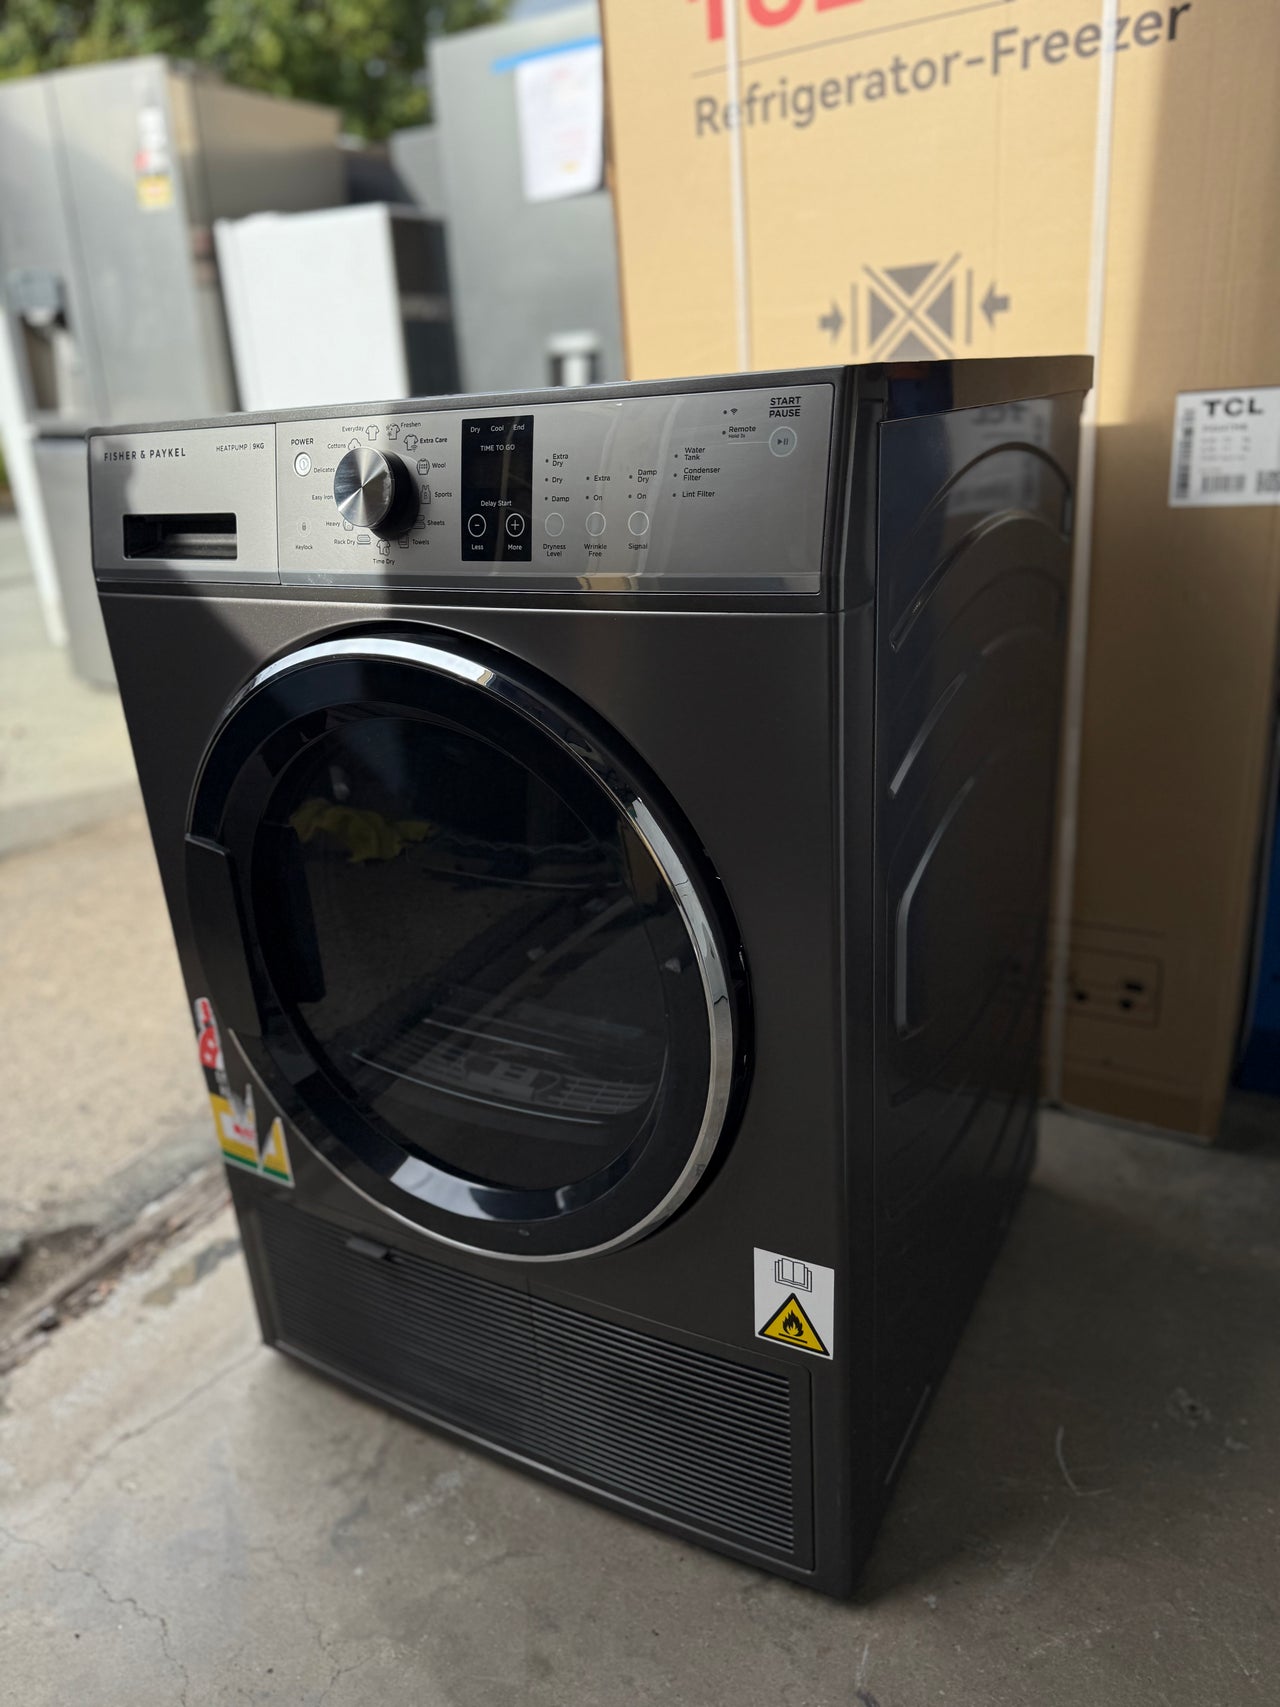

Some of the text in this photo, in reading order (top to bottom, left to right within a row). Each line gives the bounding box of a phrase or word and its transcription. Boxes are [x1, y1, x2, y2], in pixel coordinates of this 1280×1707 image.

[770, 396, 801, 405] START
[1202, 396, 1265, 418] TCL
[769, 409, 800, 418] PAUSE
[342, 425, 364, 433] Everyday
[290, 437, 314, 446] POWER
[215, 442, 265, 452] HEATPUMP 9KG
[104, 448, 186, 462] FISHER & PAYKEL
[552, 460, 564, 468] Dry
[637, 469, 657, 477] Damp
[683, 467, 720, 475] Condenser
[551, 476, 563, 484] Dry
[637, 476, 649, 484] Dry
[697, 490, 715, 498] Filter
[346, 538, 356, 546] Dry
[542, 544, 567, 552] Dryness
[627, 542, 648, 551] Signal
[385, 558, 396, 566] Dry
